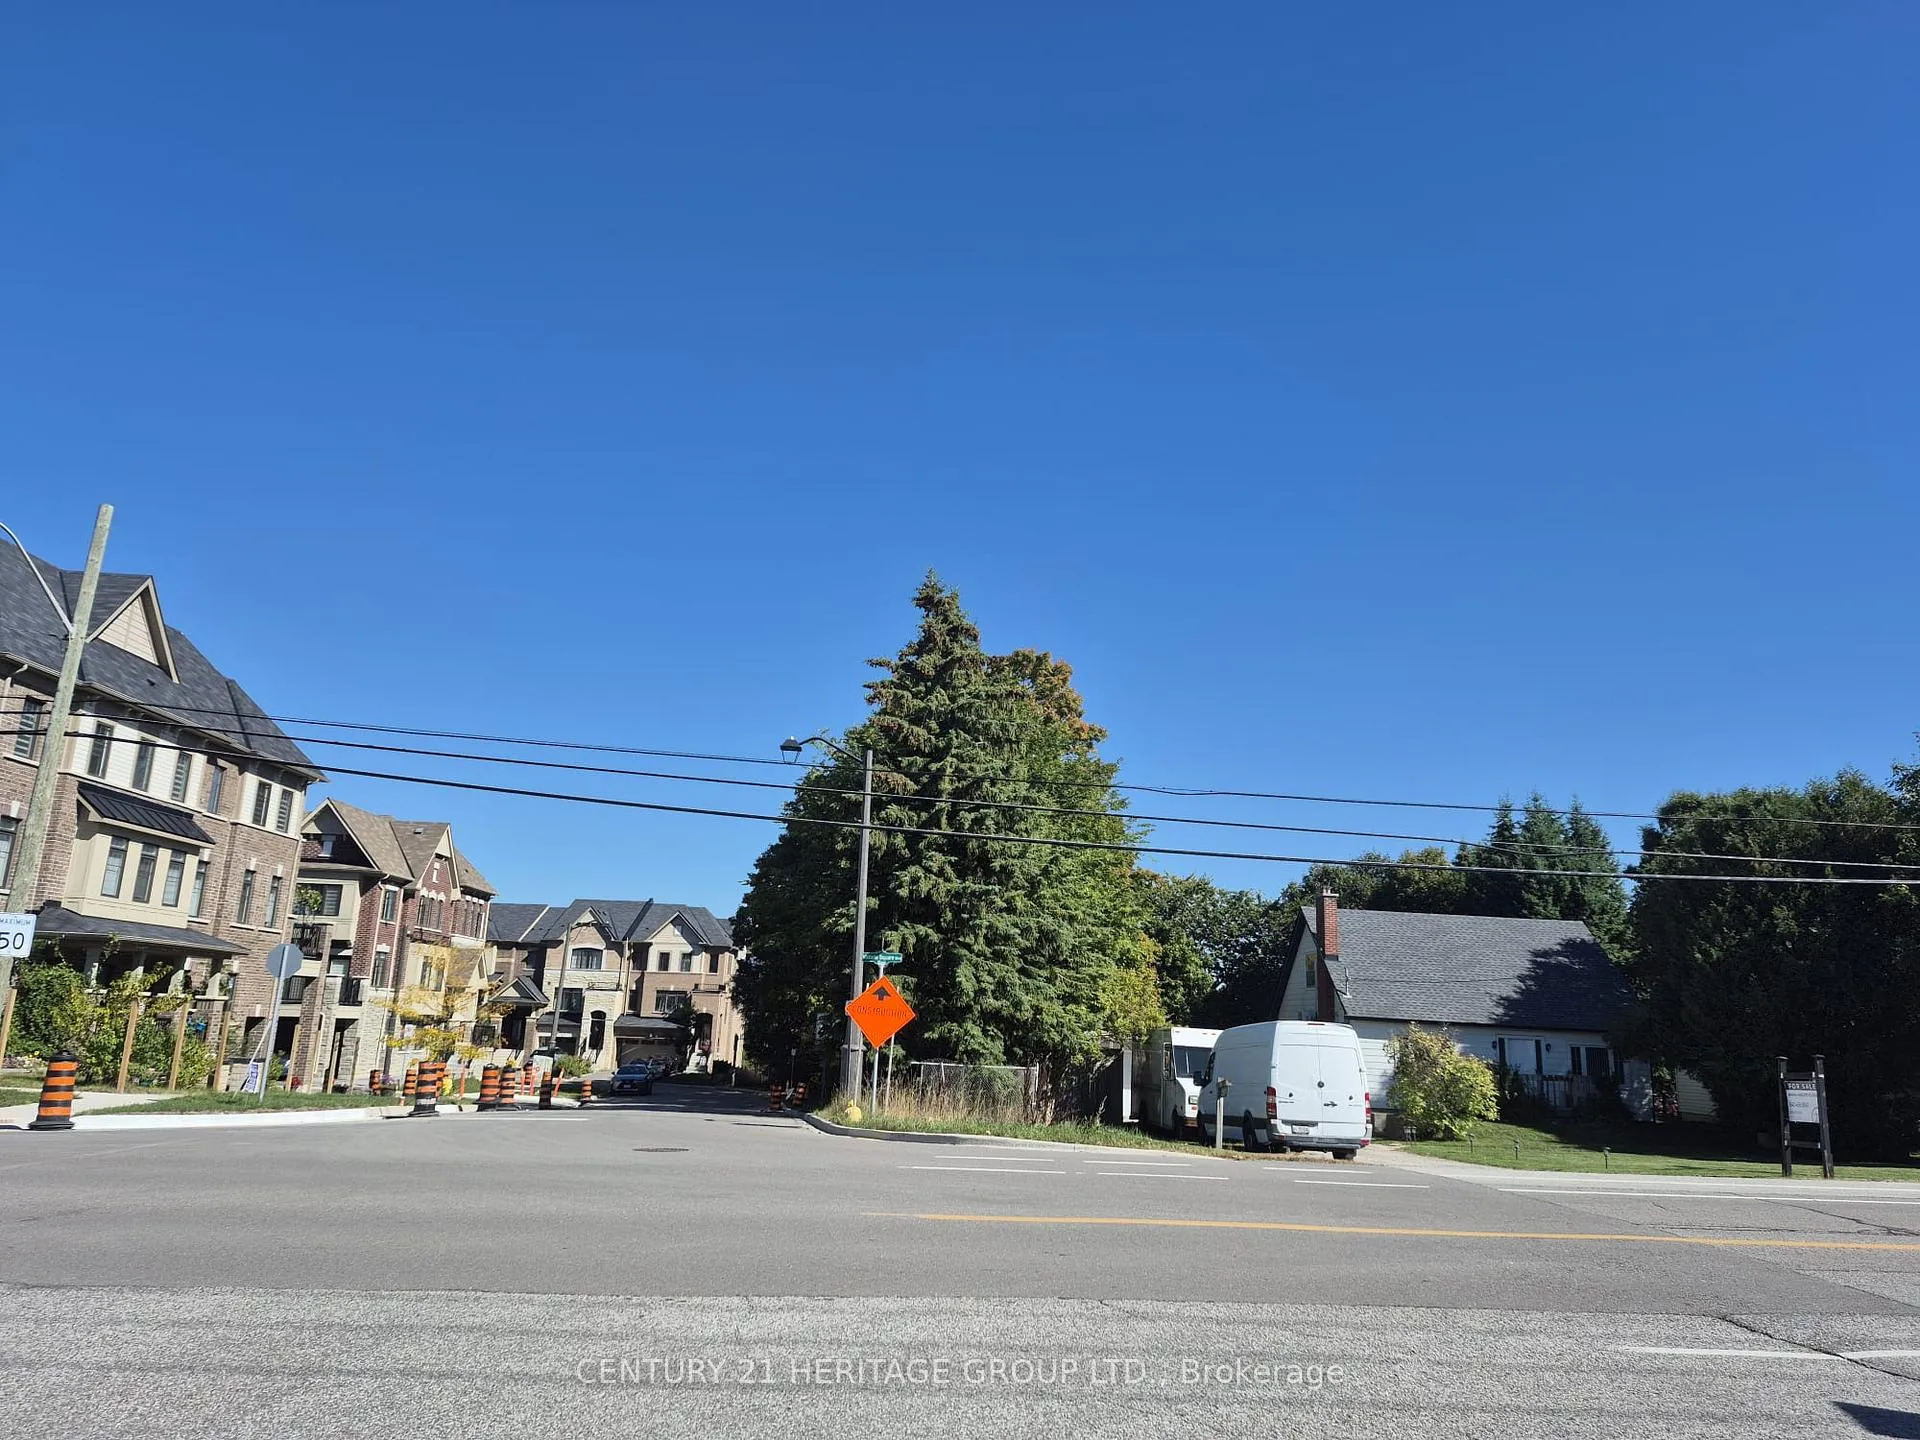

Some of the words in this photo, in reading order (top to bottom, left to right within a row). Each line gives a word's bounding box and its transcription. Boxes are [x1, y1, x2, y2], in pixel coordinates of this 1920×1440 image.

[0, 917, 31, 925] MAXIMUM
[0, 932, 25, 950] 50
[852, 1004, 907, 1019] CONSTRUCTION
